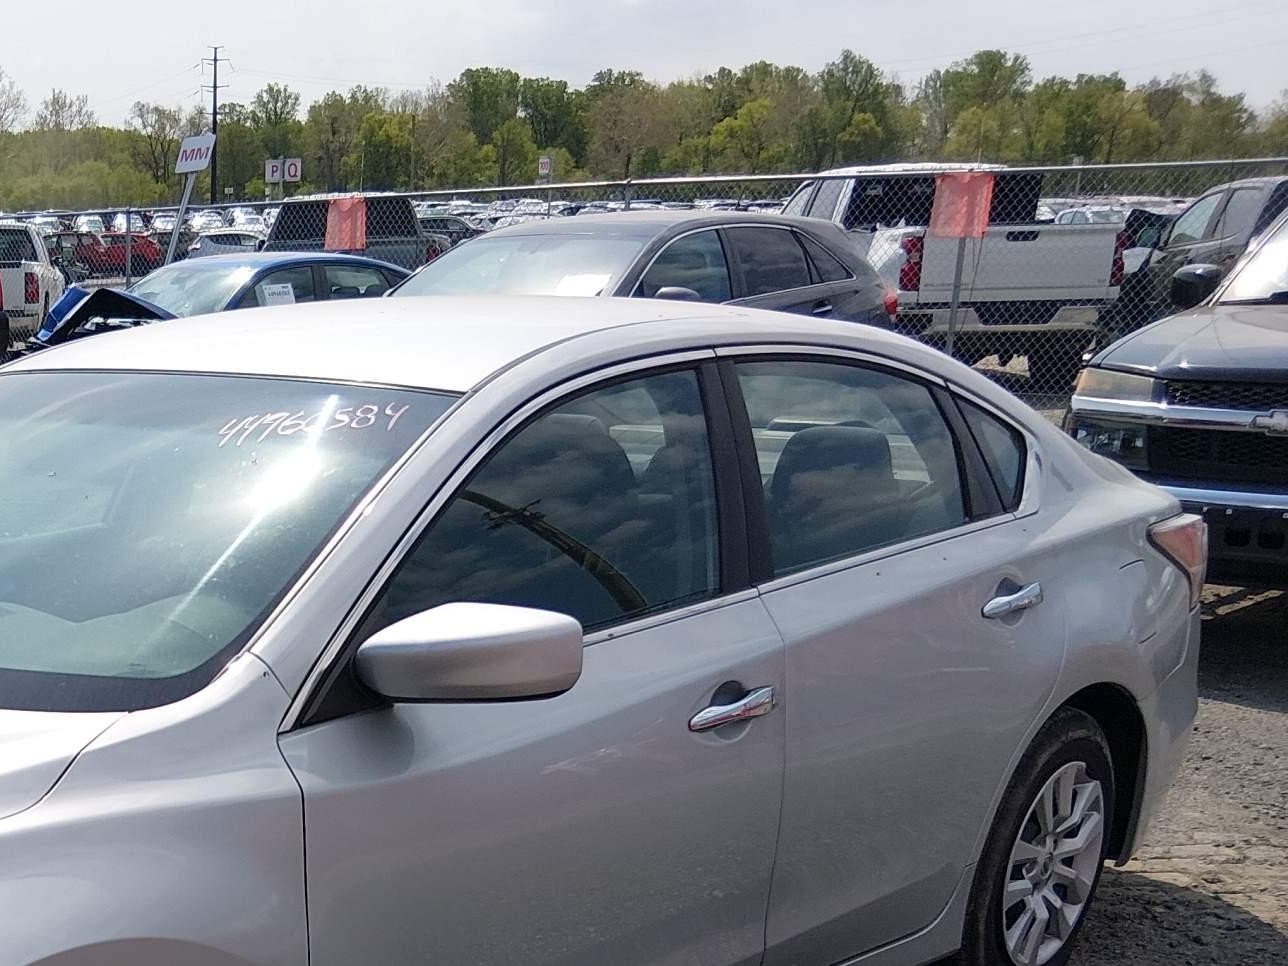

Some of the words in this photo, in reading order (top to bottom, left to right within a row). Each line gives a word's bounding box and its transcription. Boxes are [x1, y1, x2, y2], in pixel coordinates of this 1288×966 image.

[180, 146, 210, 162] MM
[271, 164, 279, 178] P
[287, 162, 299, 178] Q
